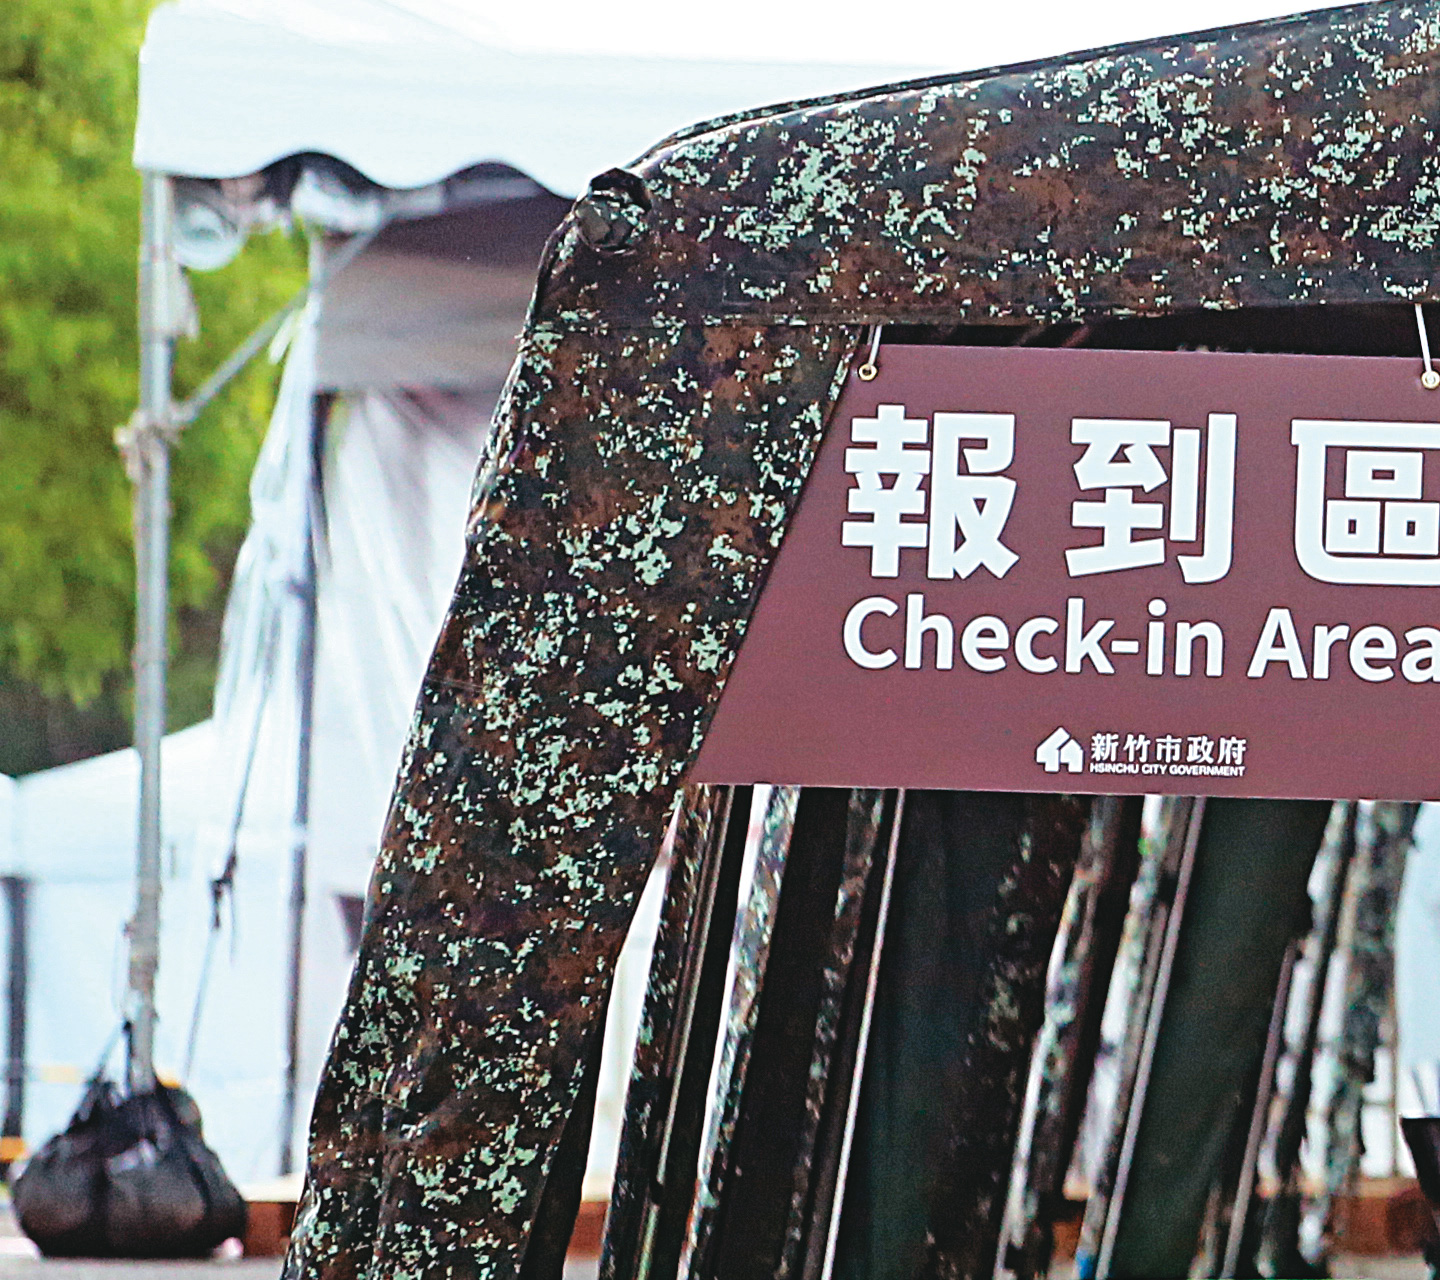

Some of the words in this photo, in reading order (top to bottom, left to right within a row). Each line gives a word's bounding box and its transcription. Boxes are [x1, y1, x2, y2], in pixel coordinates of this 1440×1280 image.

[842, 593, 1224, 678] Check-in
[1090, 732, 1247, 765] 新竹市政府
[1090, 763, 1139, 775] HSINCHU
[1141, 764, 1168, 775] CITY
[1170, 764, 1246, 777] GOVERNMENT
